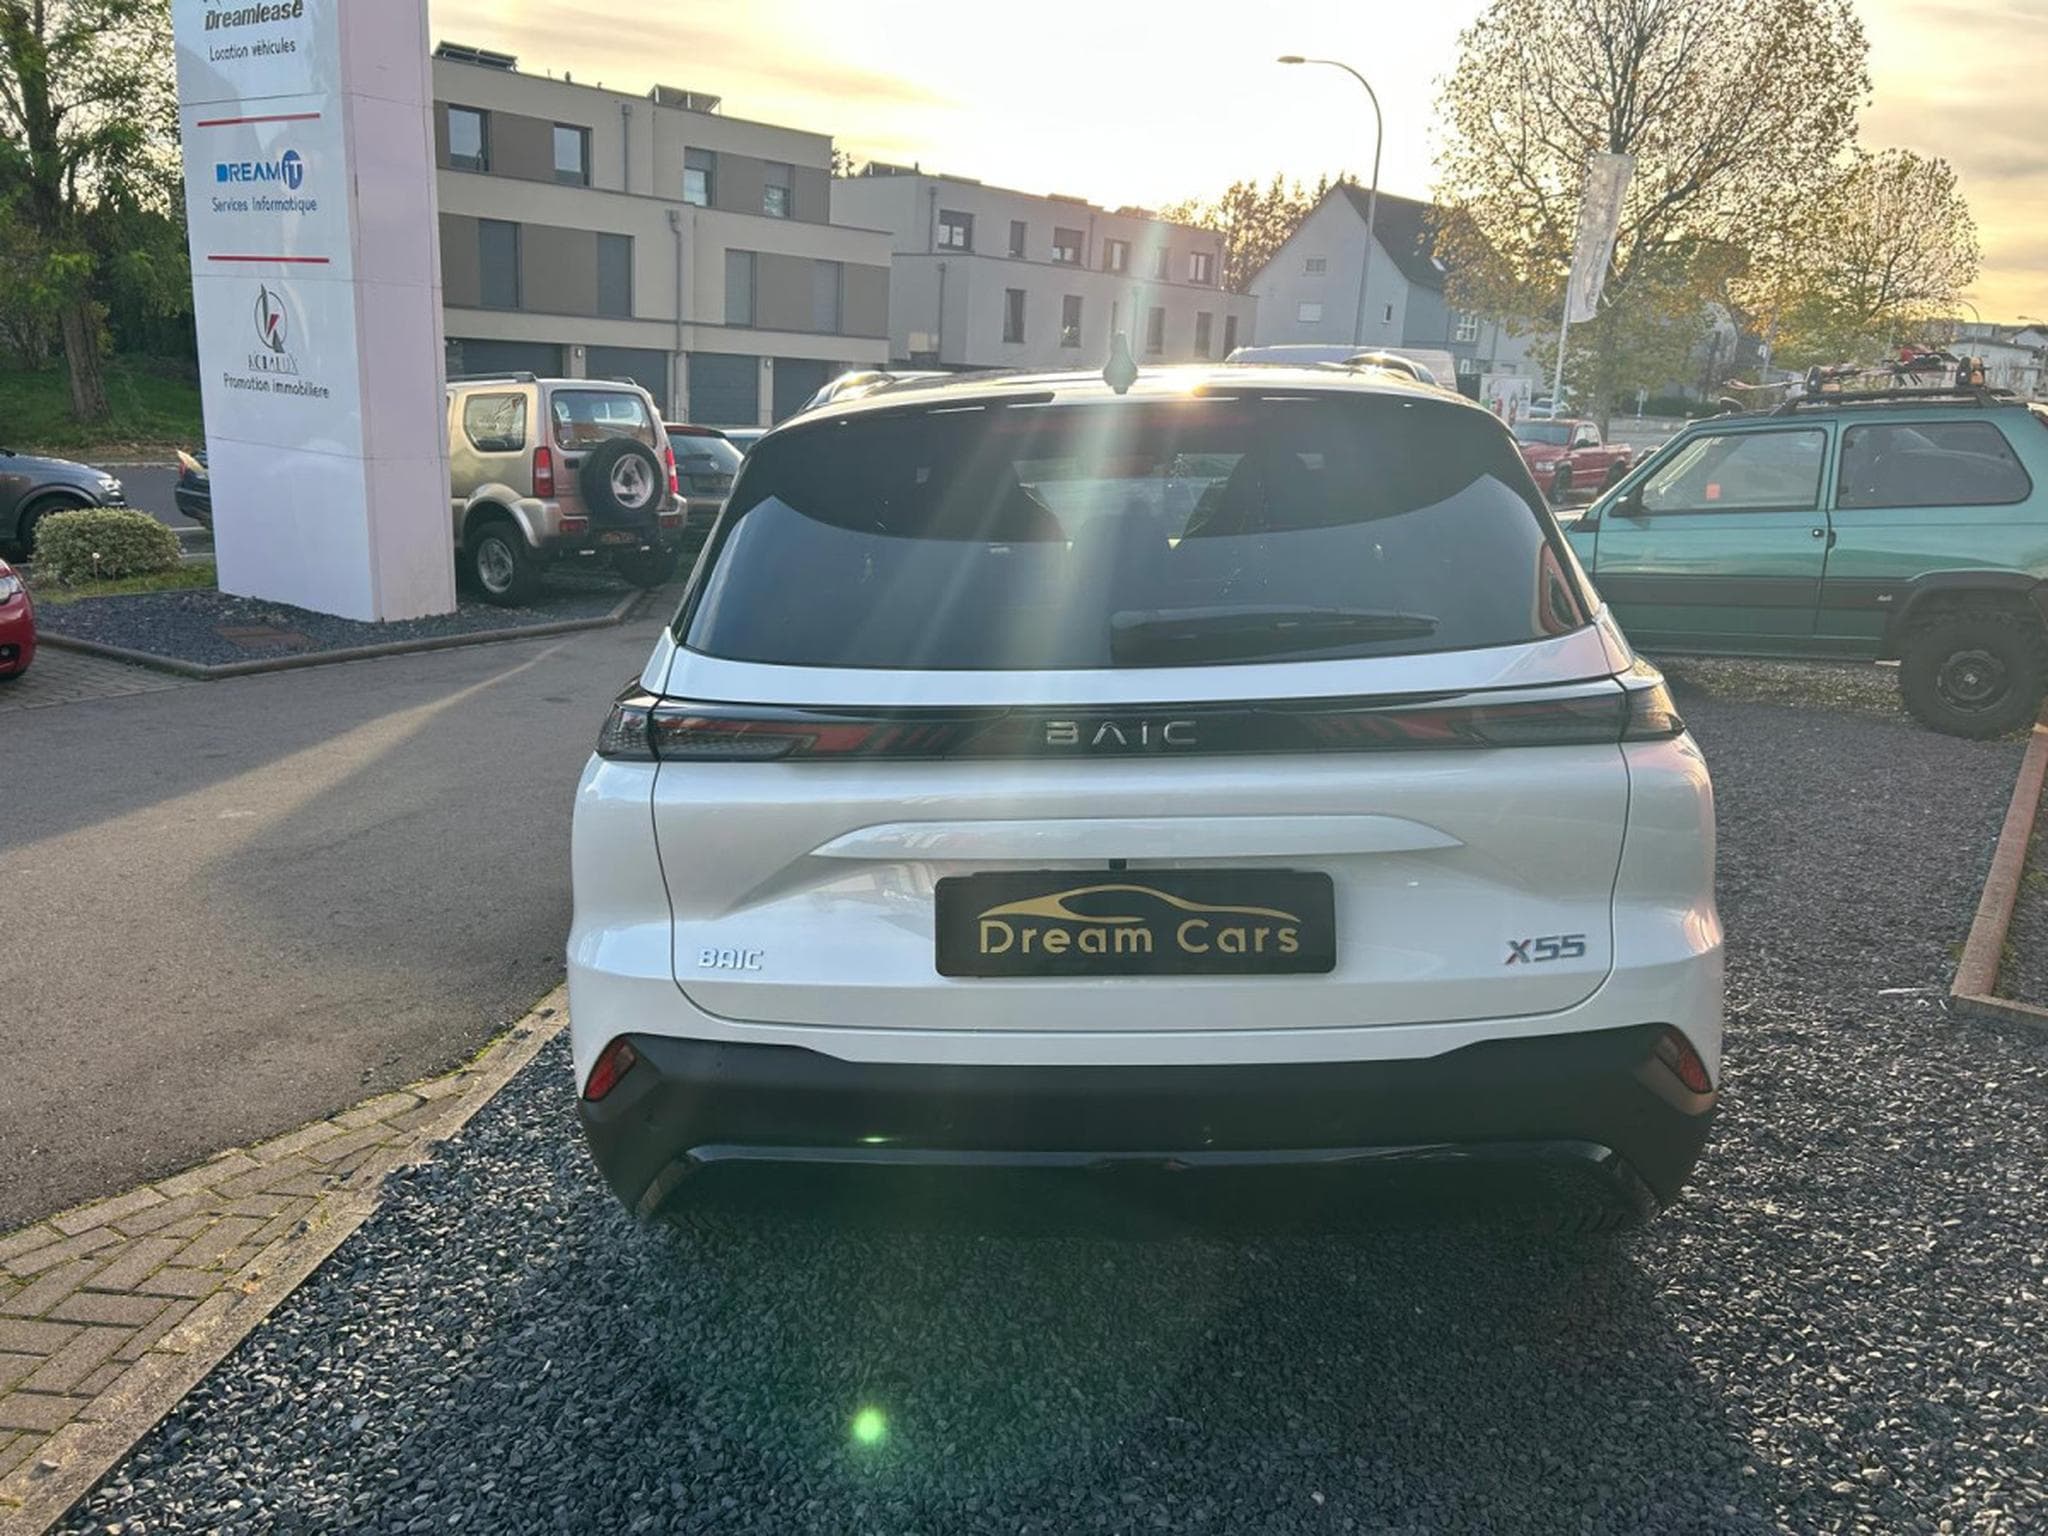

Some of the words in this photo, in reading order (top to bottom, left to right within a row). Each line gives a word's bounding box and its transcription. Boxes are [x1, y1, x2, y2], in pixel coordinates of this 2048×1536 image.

[205, 0, 303, 30] Dreamlease
[209, 45, 248, 61] Location
[212, 197, 248, 212] Services
[223, 372, 270, 392] Promotion
[1046, 721, 1197, 745] BAIC
[979, 919, 1153, 953] Dream
[1176, 919, 1300, 953] Cars
[698, 948, 764, 970] BAIC
[1505, 934, 1585, 964] X55
